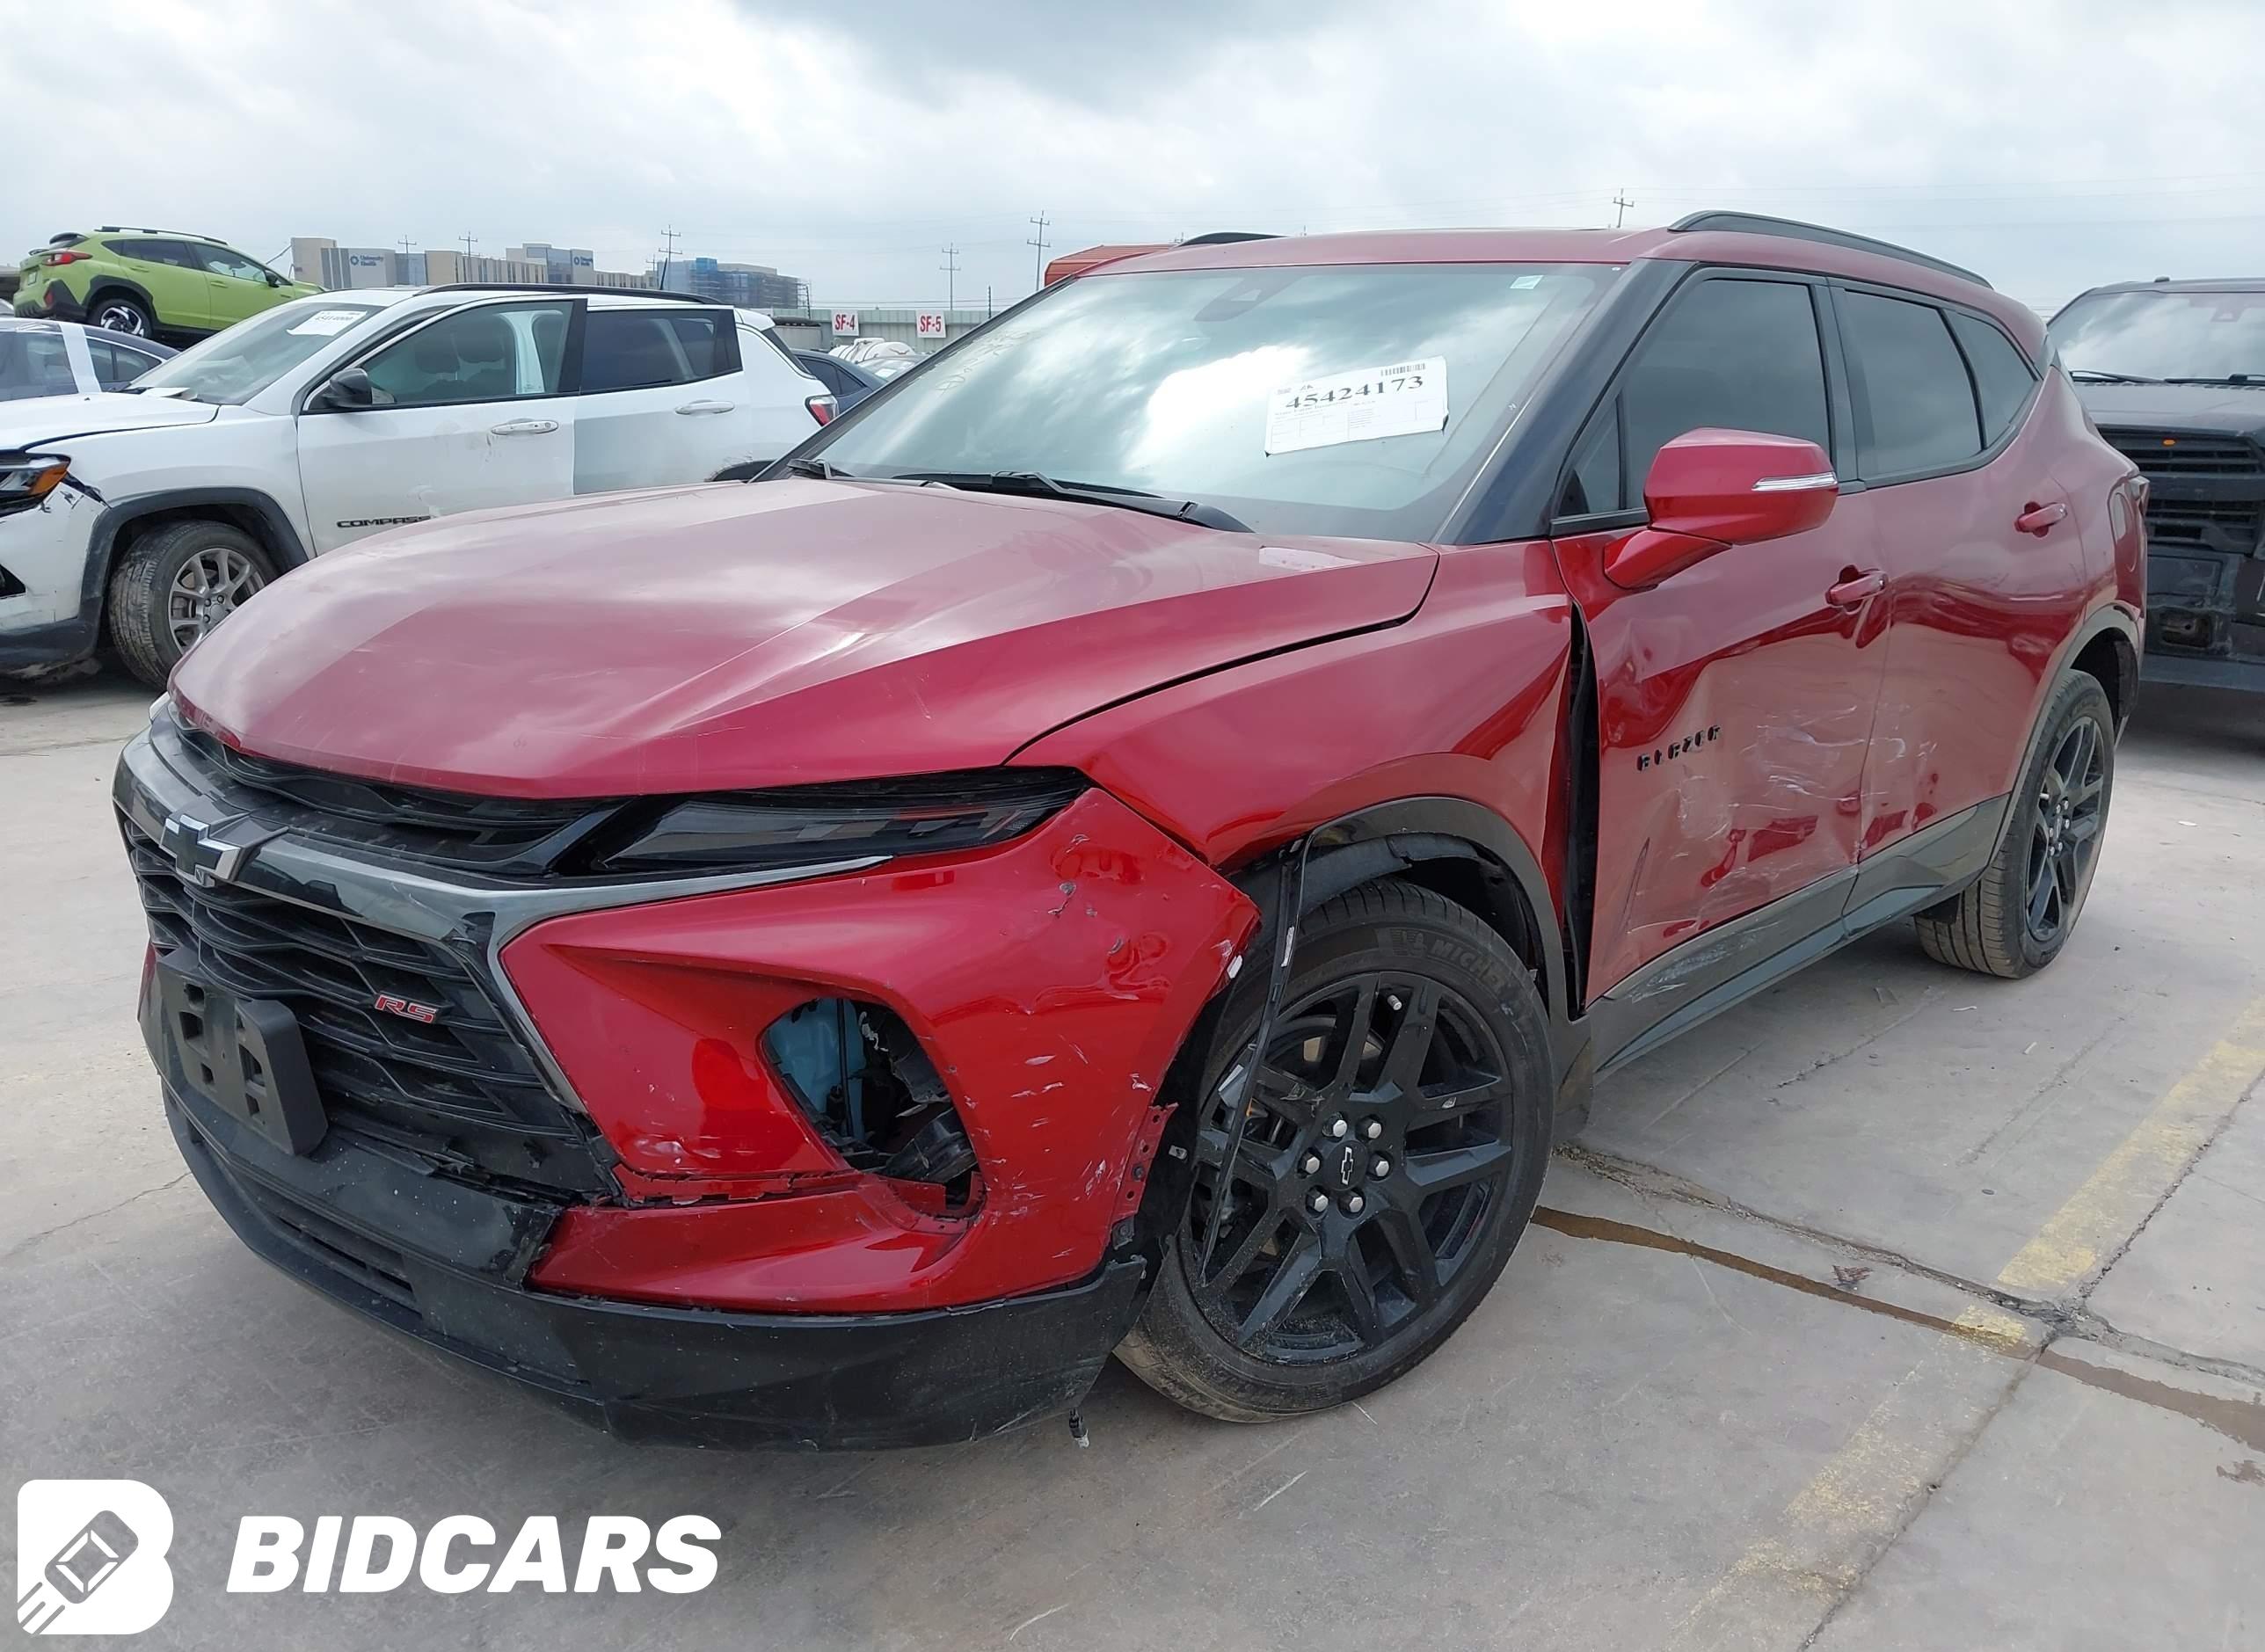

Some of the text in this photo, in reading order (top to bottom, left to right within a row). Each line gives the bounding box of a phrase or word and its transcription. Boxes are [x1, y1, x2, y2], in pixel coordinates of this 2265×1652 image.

[834, 314, 856, 331] SF-4
[920, 315, 942, 332] SF-5
[1285, 375, 1424, 409] 45424173
[375, 994, 438, 1023] RS
